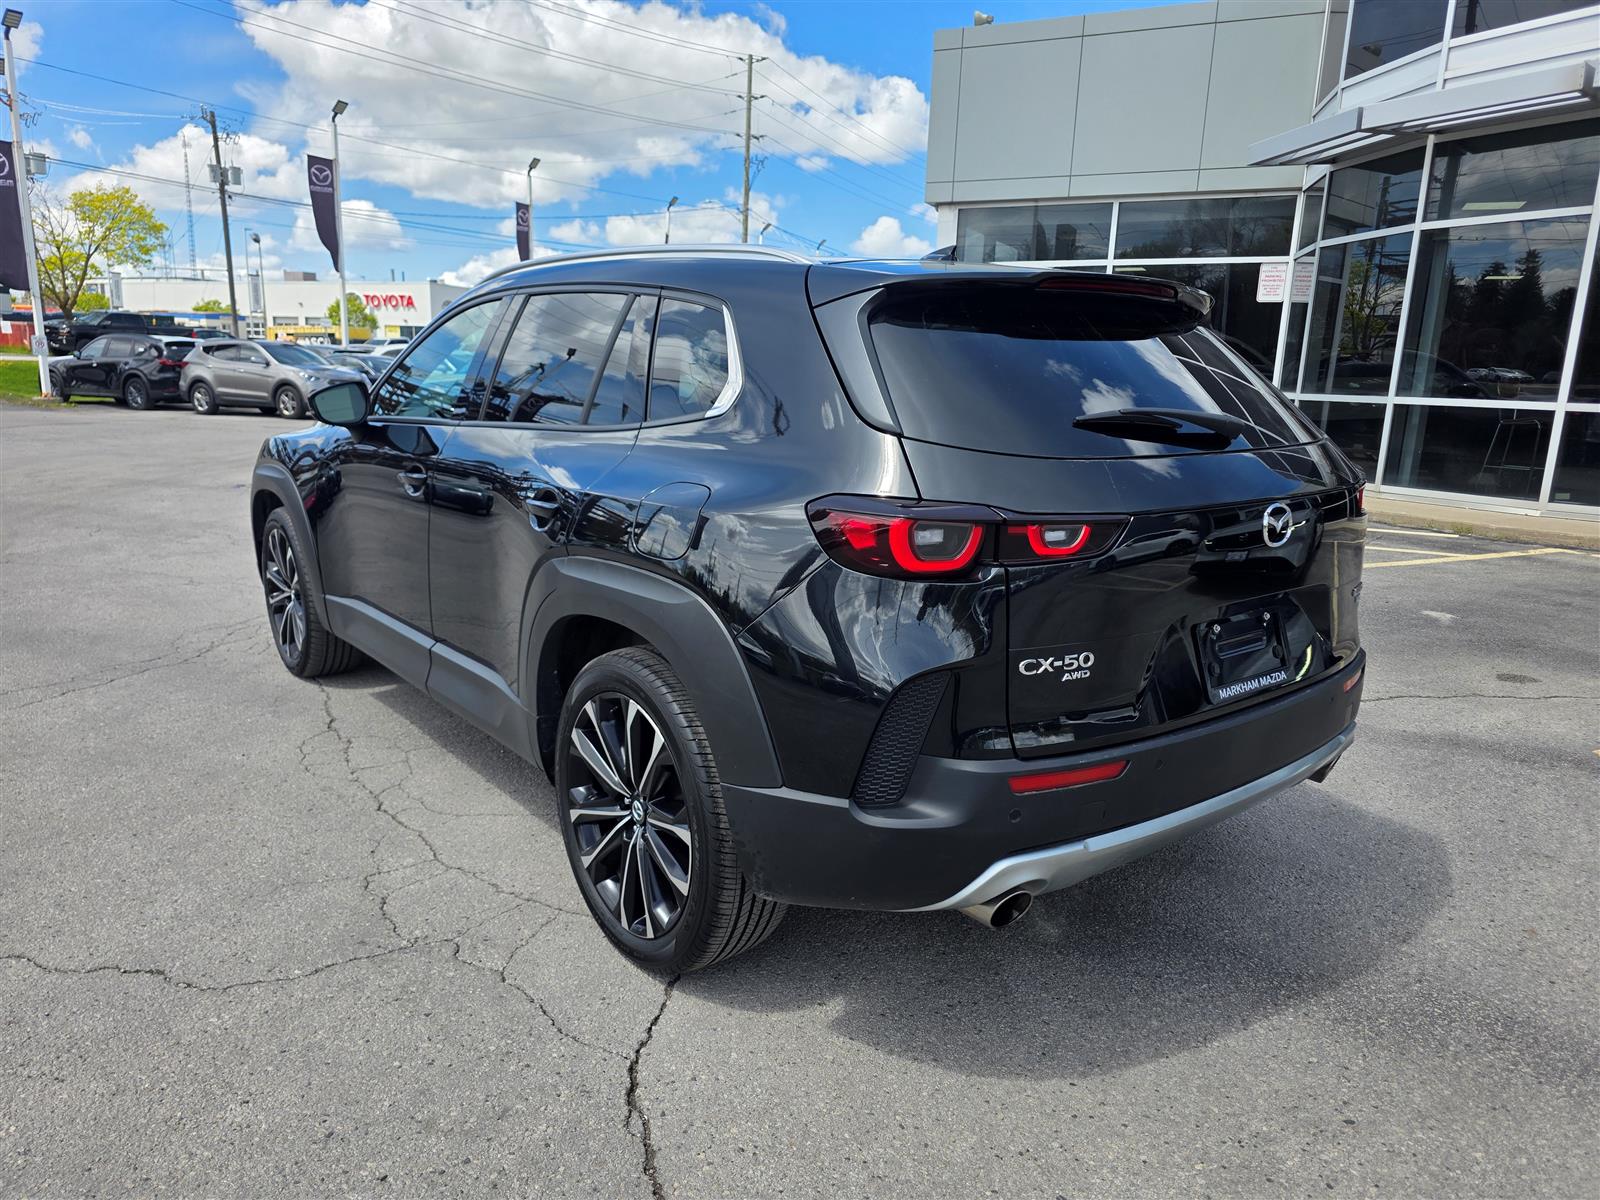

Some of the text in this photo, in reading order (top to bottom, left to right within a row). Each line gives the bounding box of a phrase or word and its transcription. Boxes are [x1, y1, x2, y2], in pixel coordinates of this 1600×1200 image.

[363, 294, 416, 308] TOYOTA
[1018, 651, 1095, 676] CX-50
[1061, 669, 1091, 682] AWD
[1219, 670, 1287, 700] MARKHAM MAZDA
